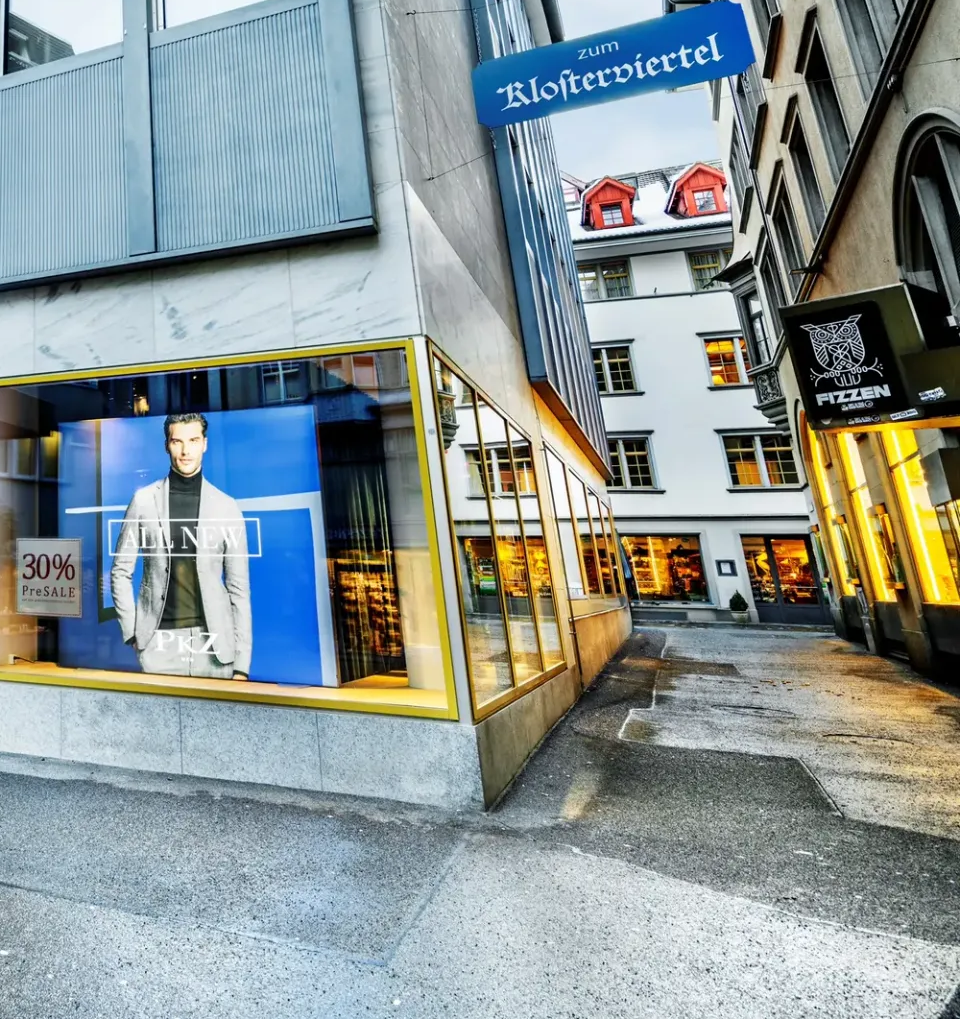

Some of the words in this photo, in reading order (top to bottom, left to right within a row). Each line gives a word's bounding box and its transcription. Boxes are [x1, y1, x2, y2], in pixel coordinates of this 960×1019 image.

[577, 41, 619, 60] zum
[815, 384, 891, 406] FIZZEN
[123, 526, 174, 549] ALL
[180, 526, 244, 550] NEW
[22, 553, 76, 580] 30%
[22, 585, 76, 598] PreSALE
[154, 629, 220, 655] PKZ
